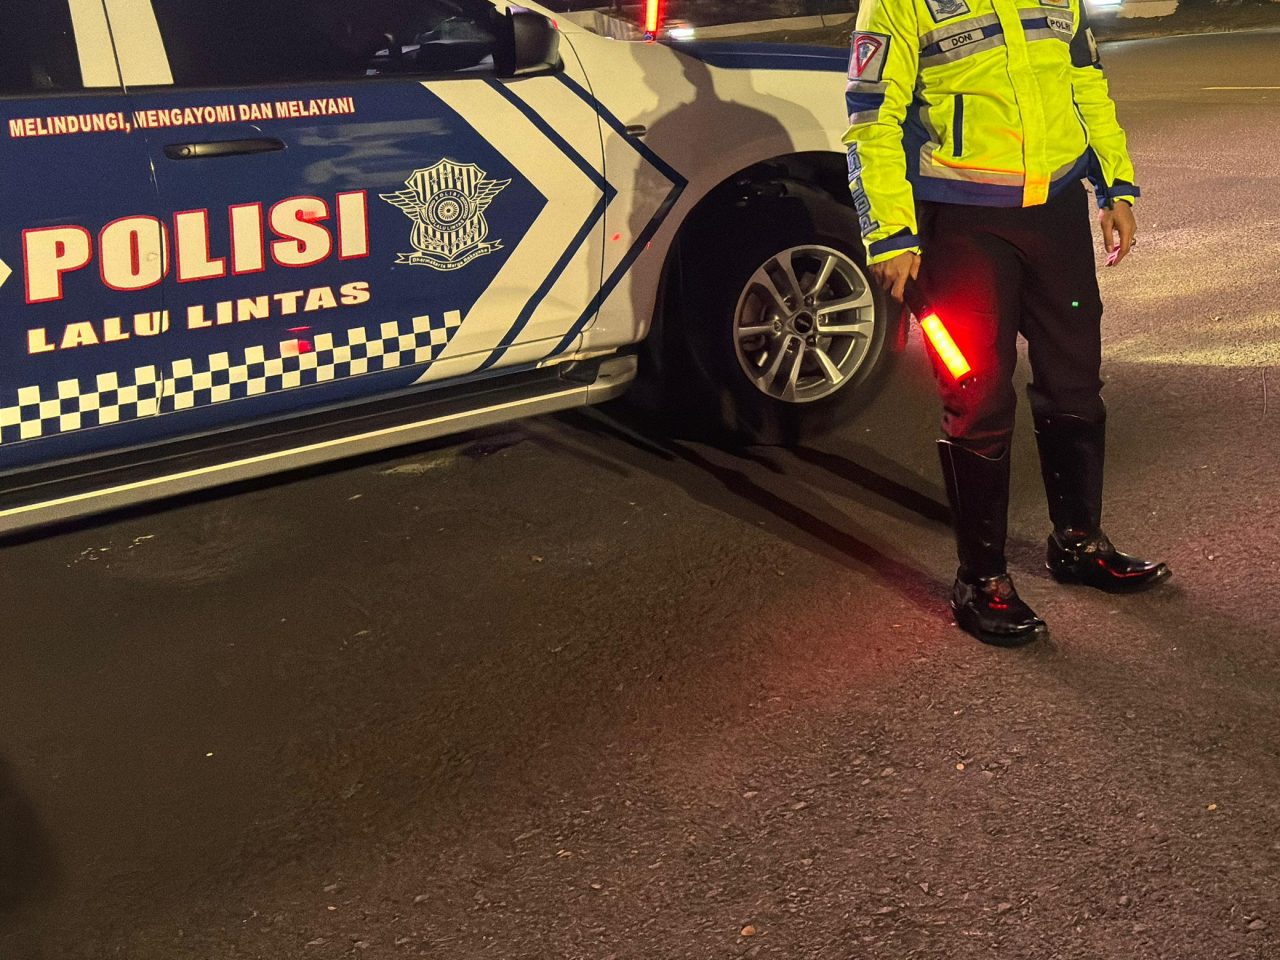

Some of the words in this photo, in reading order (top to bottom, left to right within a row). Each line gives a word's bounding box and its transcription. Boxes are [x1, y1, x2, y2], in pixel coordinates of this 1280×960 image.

[951, 33, 973, 47] DONI
[1050, 19, 1071, 32] POLRI
[9, 111, 131, 138] MELINDUNGI,
[133, 104, 237, 129] MENGAYOMI
[239, 101, 273, 121] DAN
[276, 97, 356, 119] MELAYANI
[21, 190, 370, 304] POLISI
[27, 310, 170, 354] LALU
[186, 281, 371, 330] LINTAS
